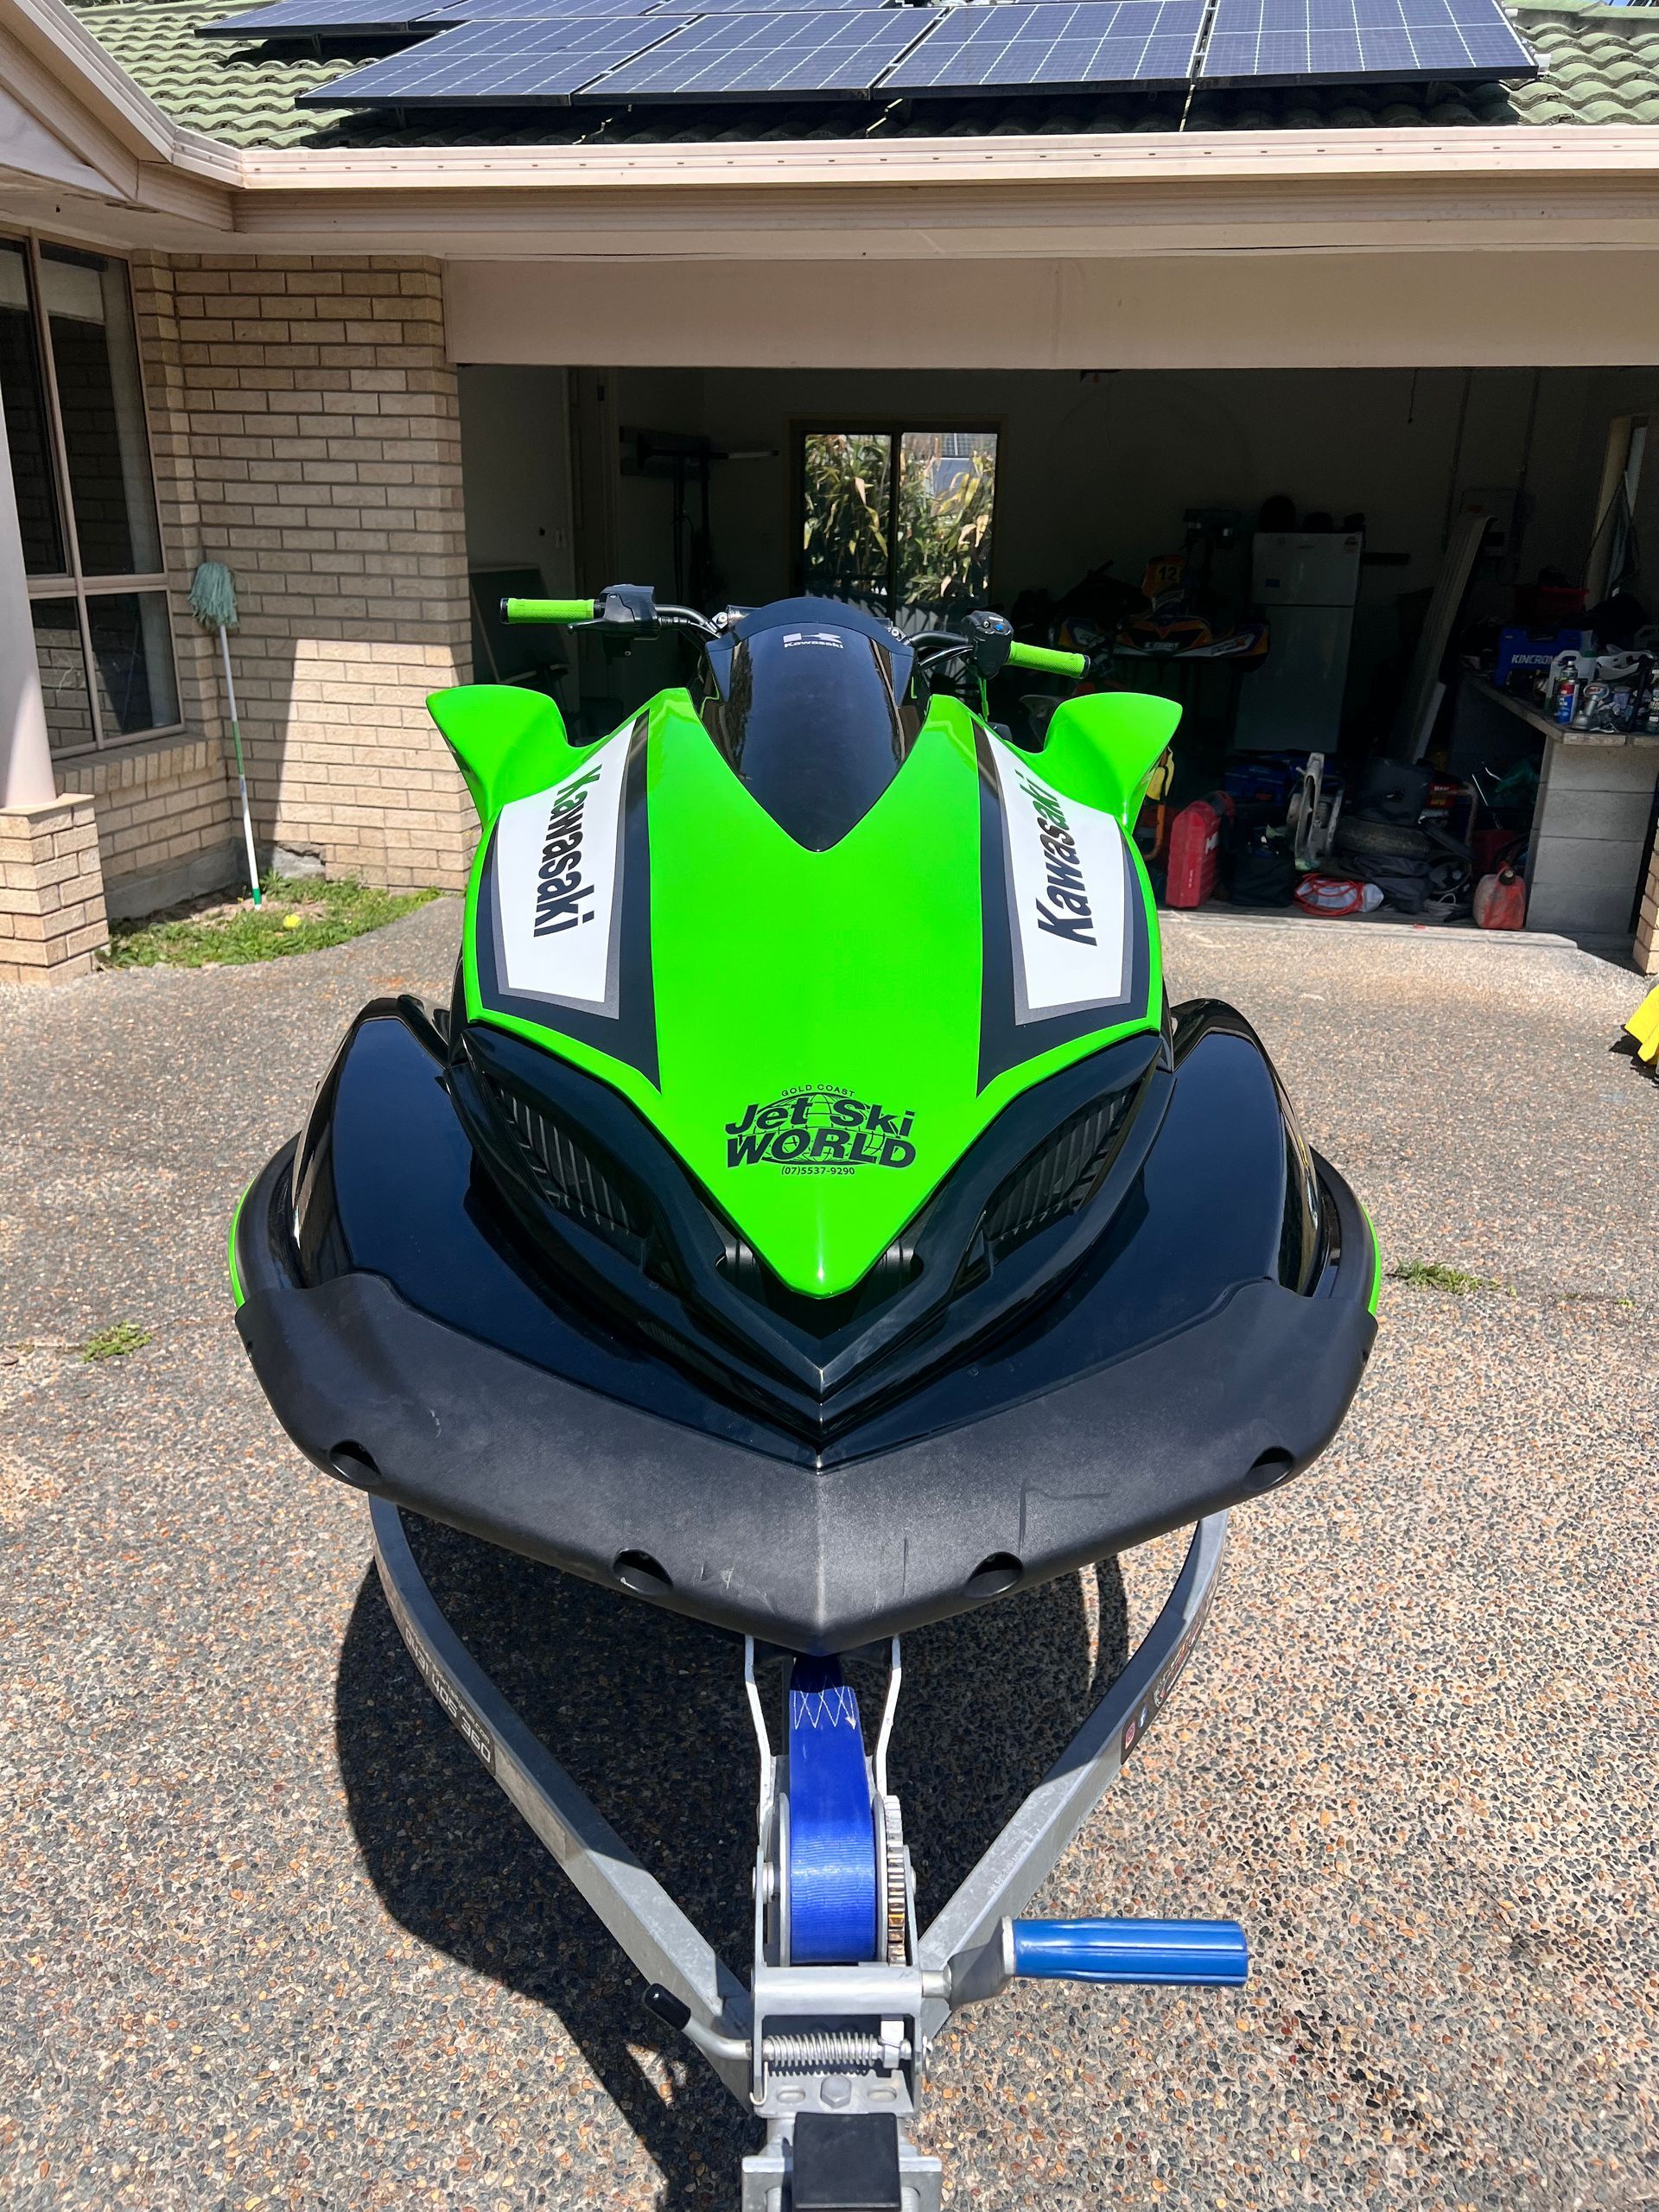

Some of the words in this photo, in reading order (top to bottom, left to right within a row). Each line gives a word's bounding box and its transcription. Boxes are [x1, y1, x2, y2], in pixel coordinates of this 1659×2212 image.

[1158, 565, 1177, 582] 12
[533, 763, 603, 938] Kawasaki
[1014, 768, 1097, 947] Kawasaki
[781, 1084, 813, 1097] GOLD
[817, 1084, 855, 1097] COAST
[725, 1096, 813, 1135] Jet
[830, 1098, 917, 1137] Ski
[727, 1128, 917, 1168] WORLD
[781, 1166, 855, 1176] (07)5537-9290
[404, 1627, 429, 1675] 0431
[431, 1673, 459, 1719] 405
[461, 1716, 491, 1764] 360
